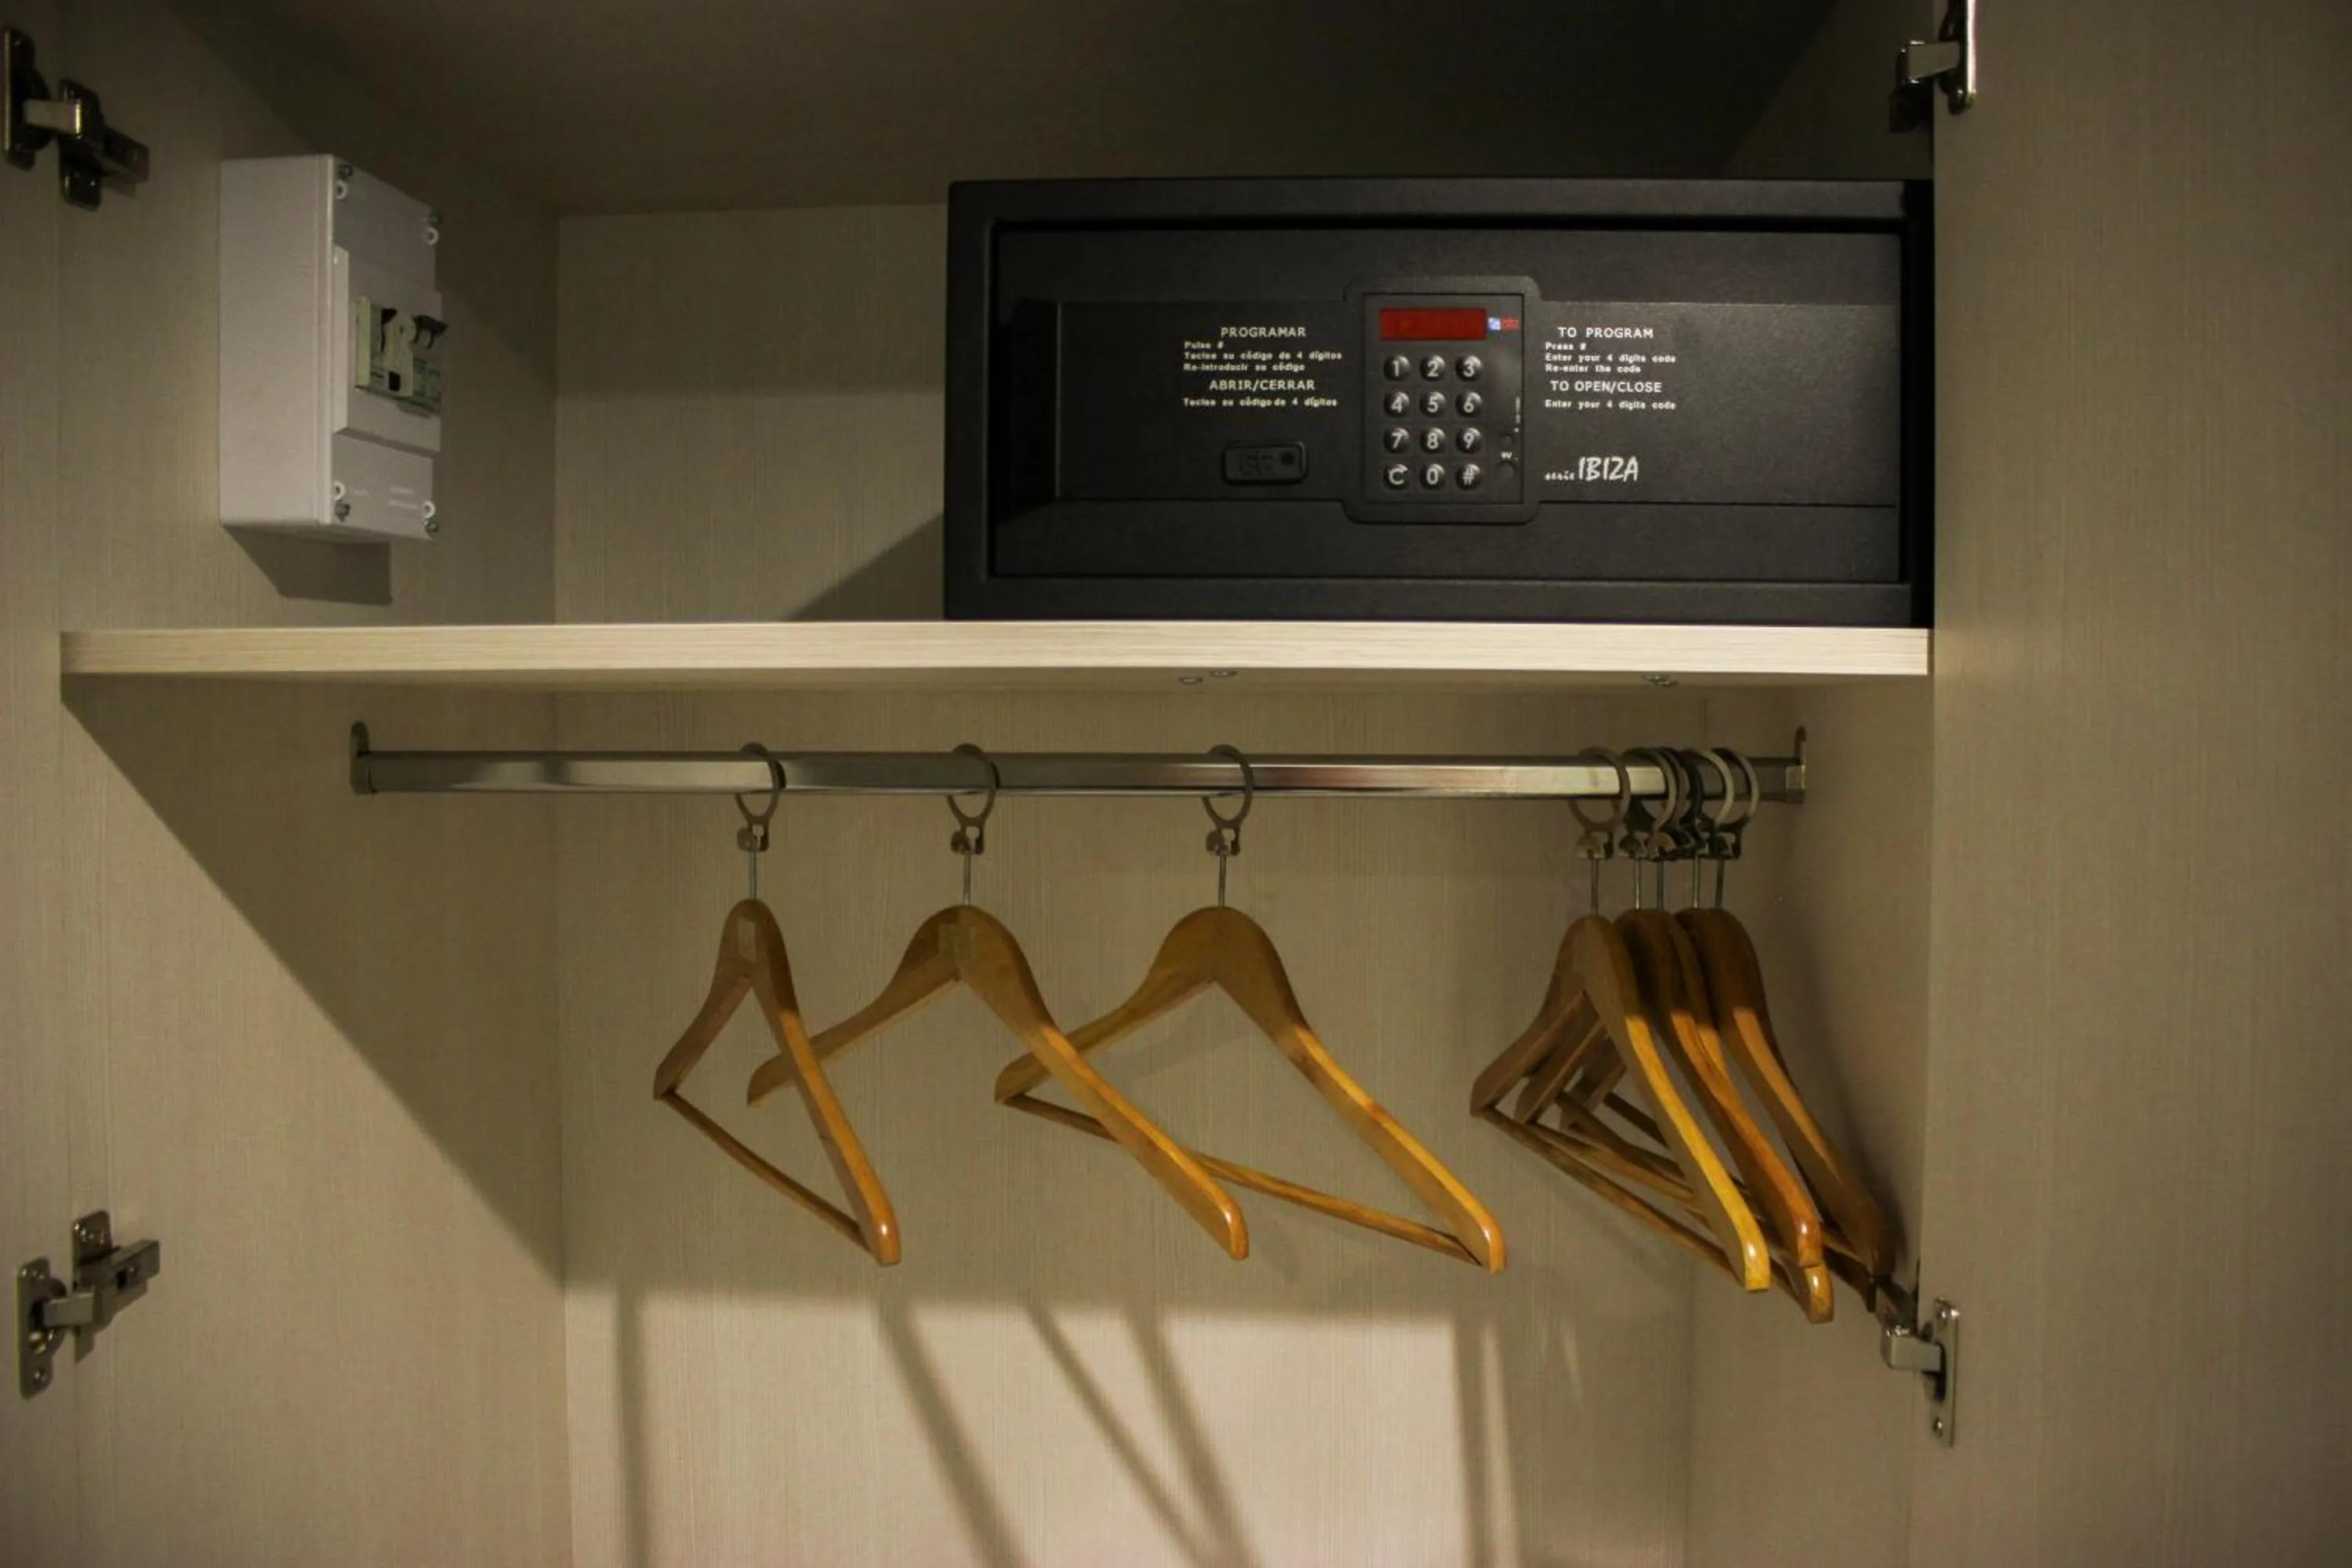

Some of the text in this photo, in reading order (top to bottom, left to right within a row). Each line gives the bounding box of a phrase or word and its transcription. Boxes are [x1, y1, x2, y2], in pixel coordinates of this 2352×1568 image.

[1221, 327, 1307, 338] PROGRAMAR
[1558, 327, 1654, 338] TO PROGRAM
[1545, 342, 1573, 350] Press
[1545, 353, 1572, 361] Enter
[1619, 354, 1646, 363] digits
[1392, 361, 1475, 377] 1 2 3
[1617, 365, 1642, 373] code
[1209, 379, 1316, 391] ABRIR/CERRAR
[1550, 380, 1663, 394] TO OPEN/CLOSE
[1392, 397, 1475, 413] 4 5 6
[1545, 399, 1572, 408] Enter
[1578, 401, 1600, 410] your
[1618, 400, 1646, 410] digits
[1652, 401, 1676, 409] code
[1392, 432, 1475, 449] 7 8 9
[1578, 456, 1639, 481] IBIZA
[1389, 469, 1475, 485] C 0 #
